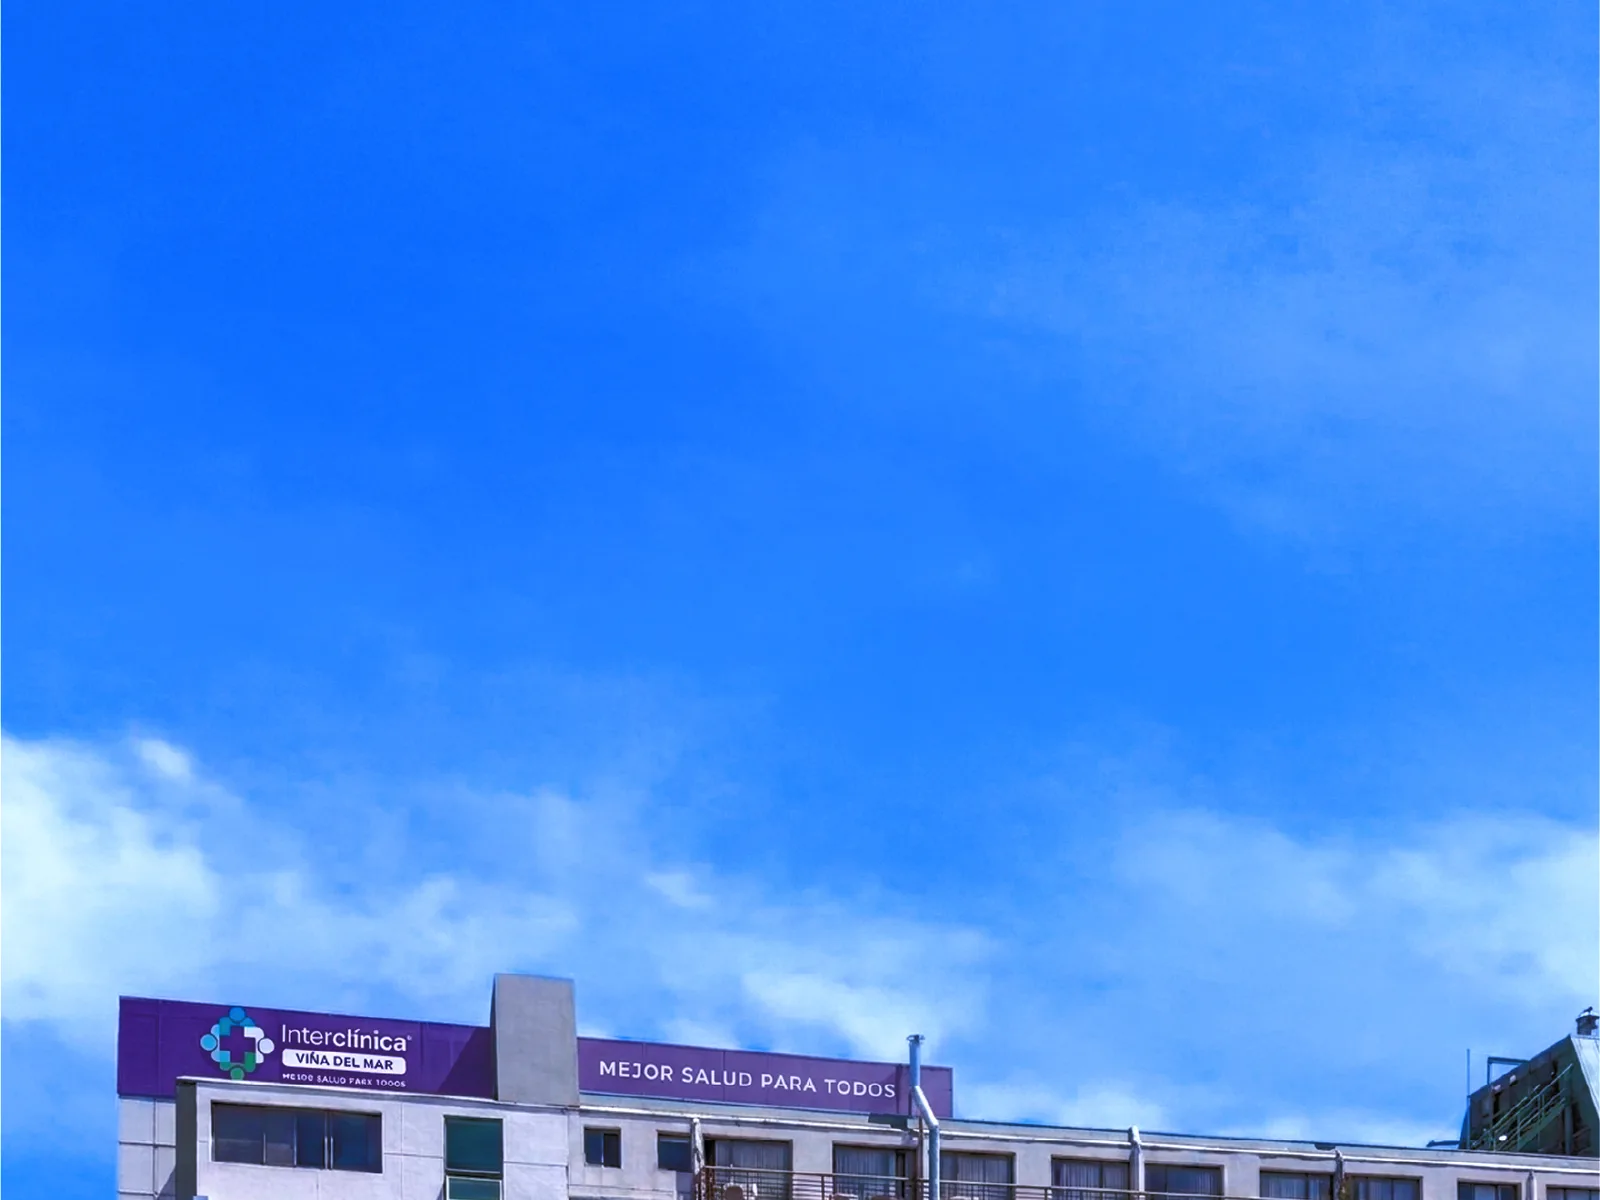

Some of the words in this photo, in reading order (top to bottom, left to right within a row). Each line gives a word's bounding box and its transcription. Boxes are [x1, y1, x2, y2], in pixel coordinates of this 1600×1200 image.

[295, 1051, 330, 1066] VIÑA
[333, 1055, 360, 1068] DEL
[363, 1058, 394, 1071] MAR
[599, 1060, 674, 1082] MEJOR
[681, 1066, 753, 1087] SALUD
[760, 1073, 818, 1093] PARA
[823, 1078, 896, 1098] TODOS
